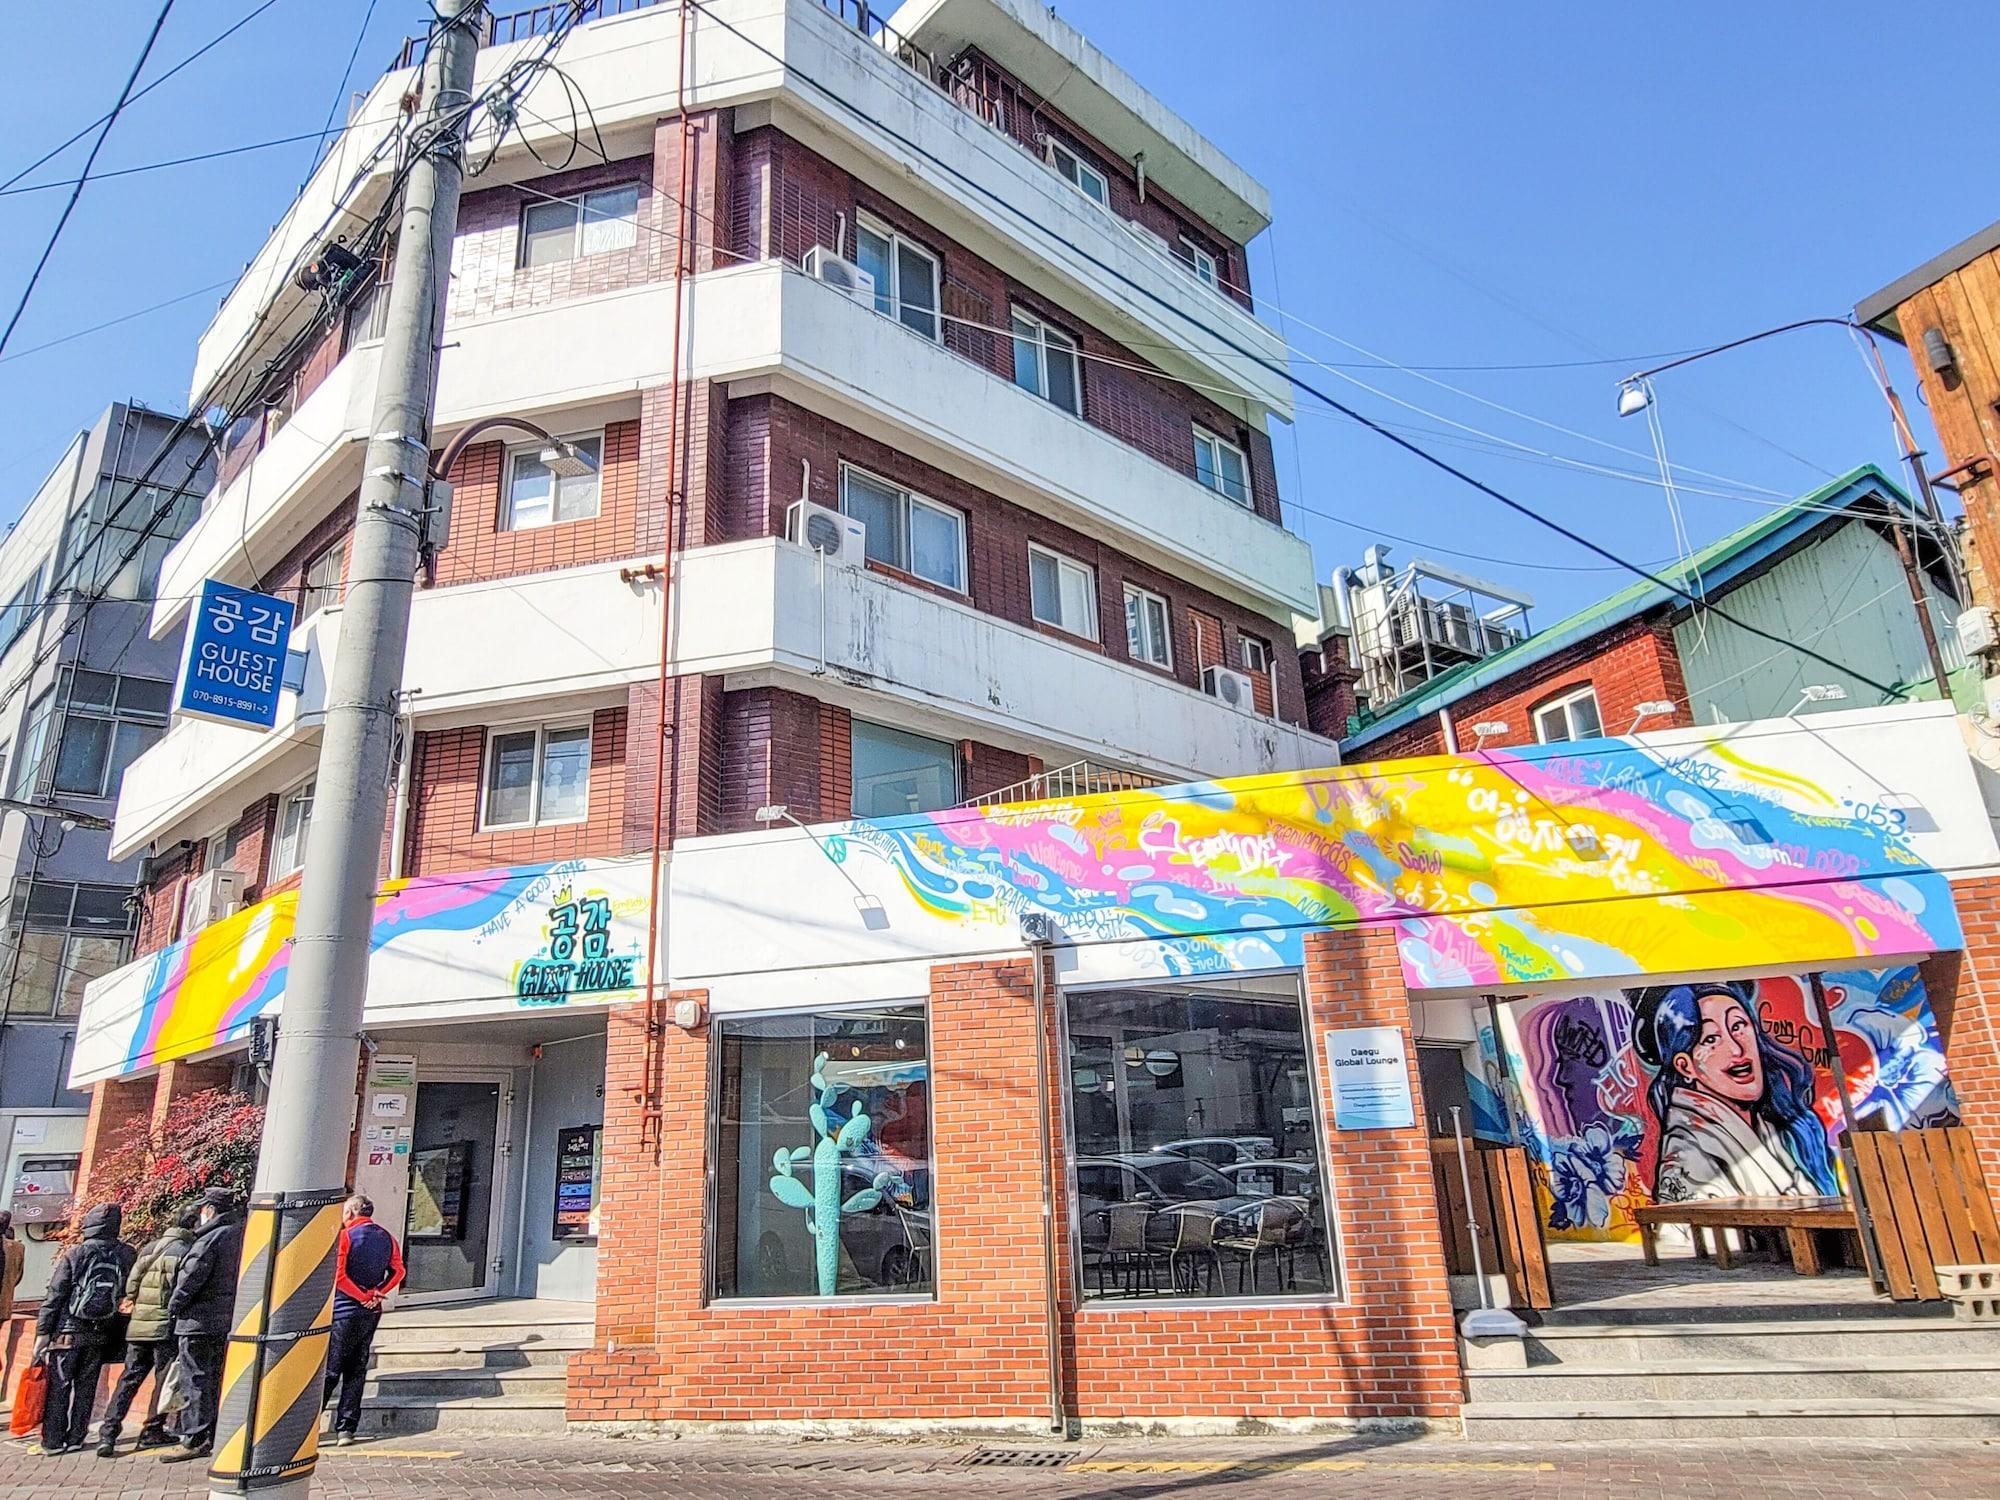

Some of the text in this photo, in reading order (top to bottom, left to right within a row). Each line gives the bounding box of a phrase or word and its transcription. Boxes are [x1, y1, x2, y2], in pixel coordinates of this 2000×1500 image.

[208, 595, 285, 645] 공감
[201, 642, 277, 674] GUEST
[197, 660, 274, 693] HOUSE
[1855, 802, 1907, 837] 053
[480, 911, 512, 937] HAVE
[515, 900, 526, 915] A
[525, 876, 551, 903] GOOD
[996, 884, 1032, 915] PEACE
[1296, 896, 1341, 921] NOW
[548, 897, 612, 960] 공감
[574, 957, 634, 990] HOUSE
[1758, 1001, 1799, 1045] Gong
[1335, 1057, 1398, 1067] Global Lounge
[1350, 1048, 1380, 1057] Daegu
[1591, 1058, 1638, 1105] ETC
